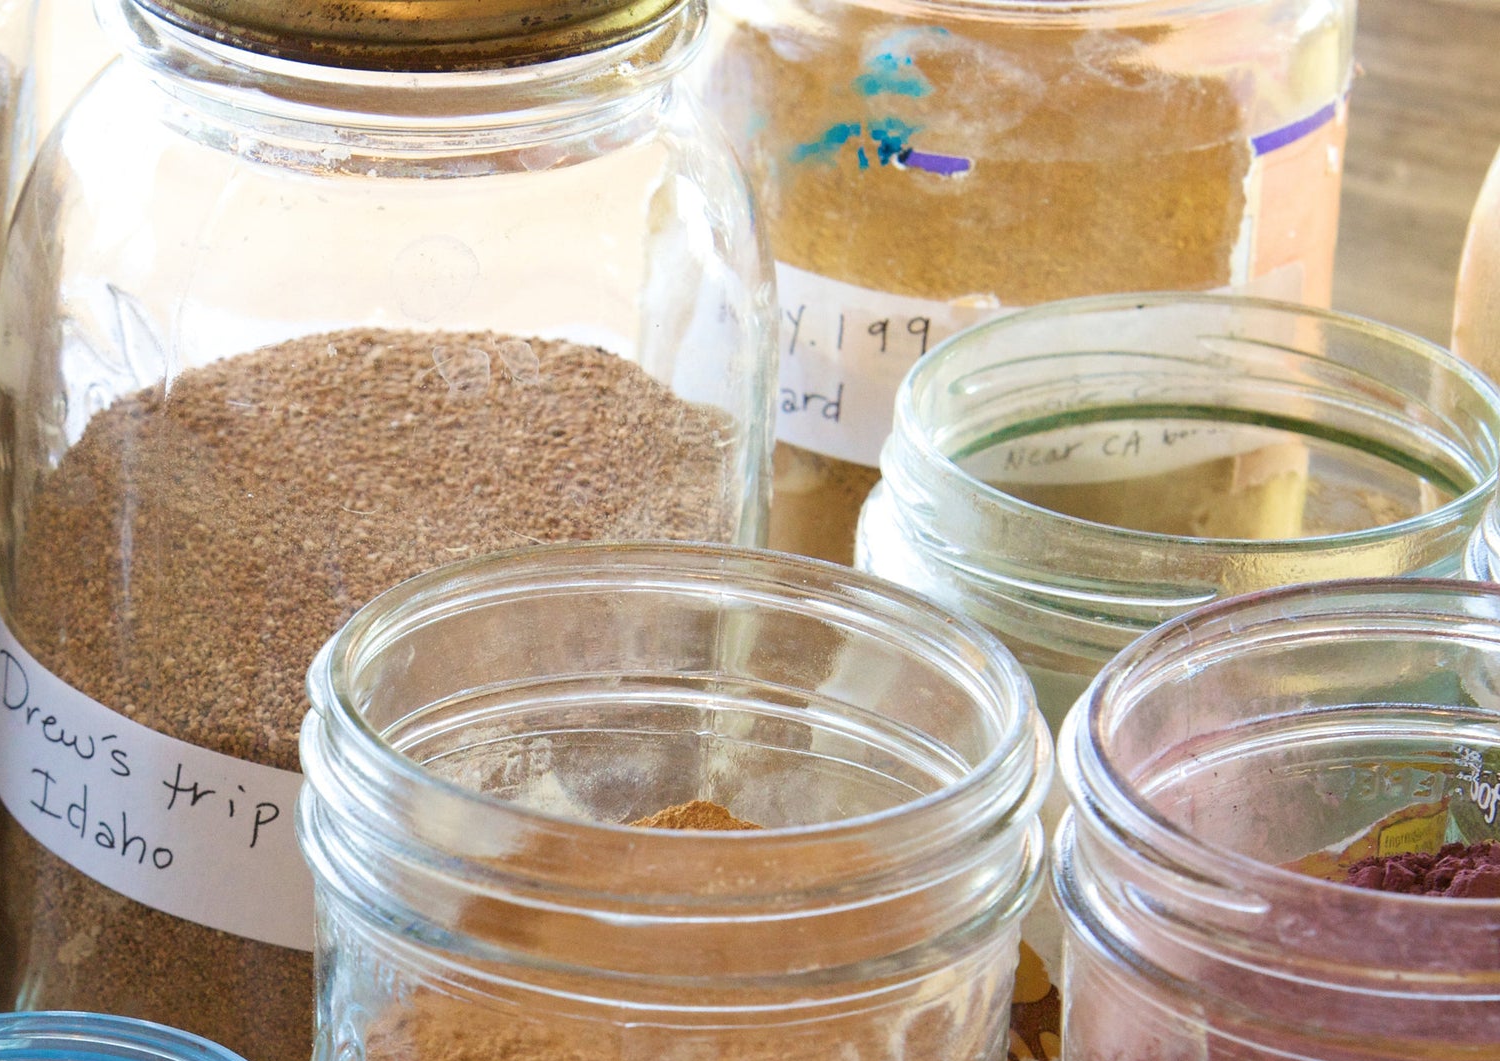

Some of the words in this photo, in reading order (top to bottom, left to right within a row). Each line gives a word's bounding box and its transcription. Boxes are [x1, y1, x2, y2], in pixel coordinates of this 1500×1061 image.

[838, 313, 931, 356] 199
[1003, 441, 1083, 471] Near
[1101, 430, 1143, 457] CA
[0, 649, 131, 777] Drew's
[162, 763, 280, 849] trip
[30, 767, 174, 869] Idaho
